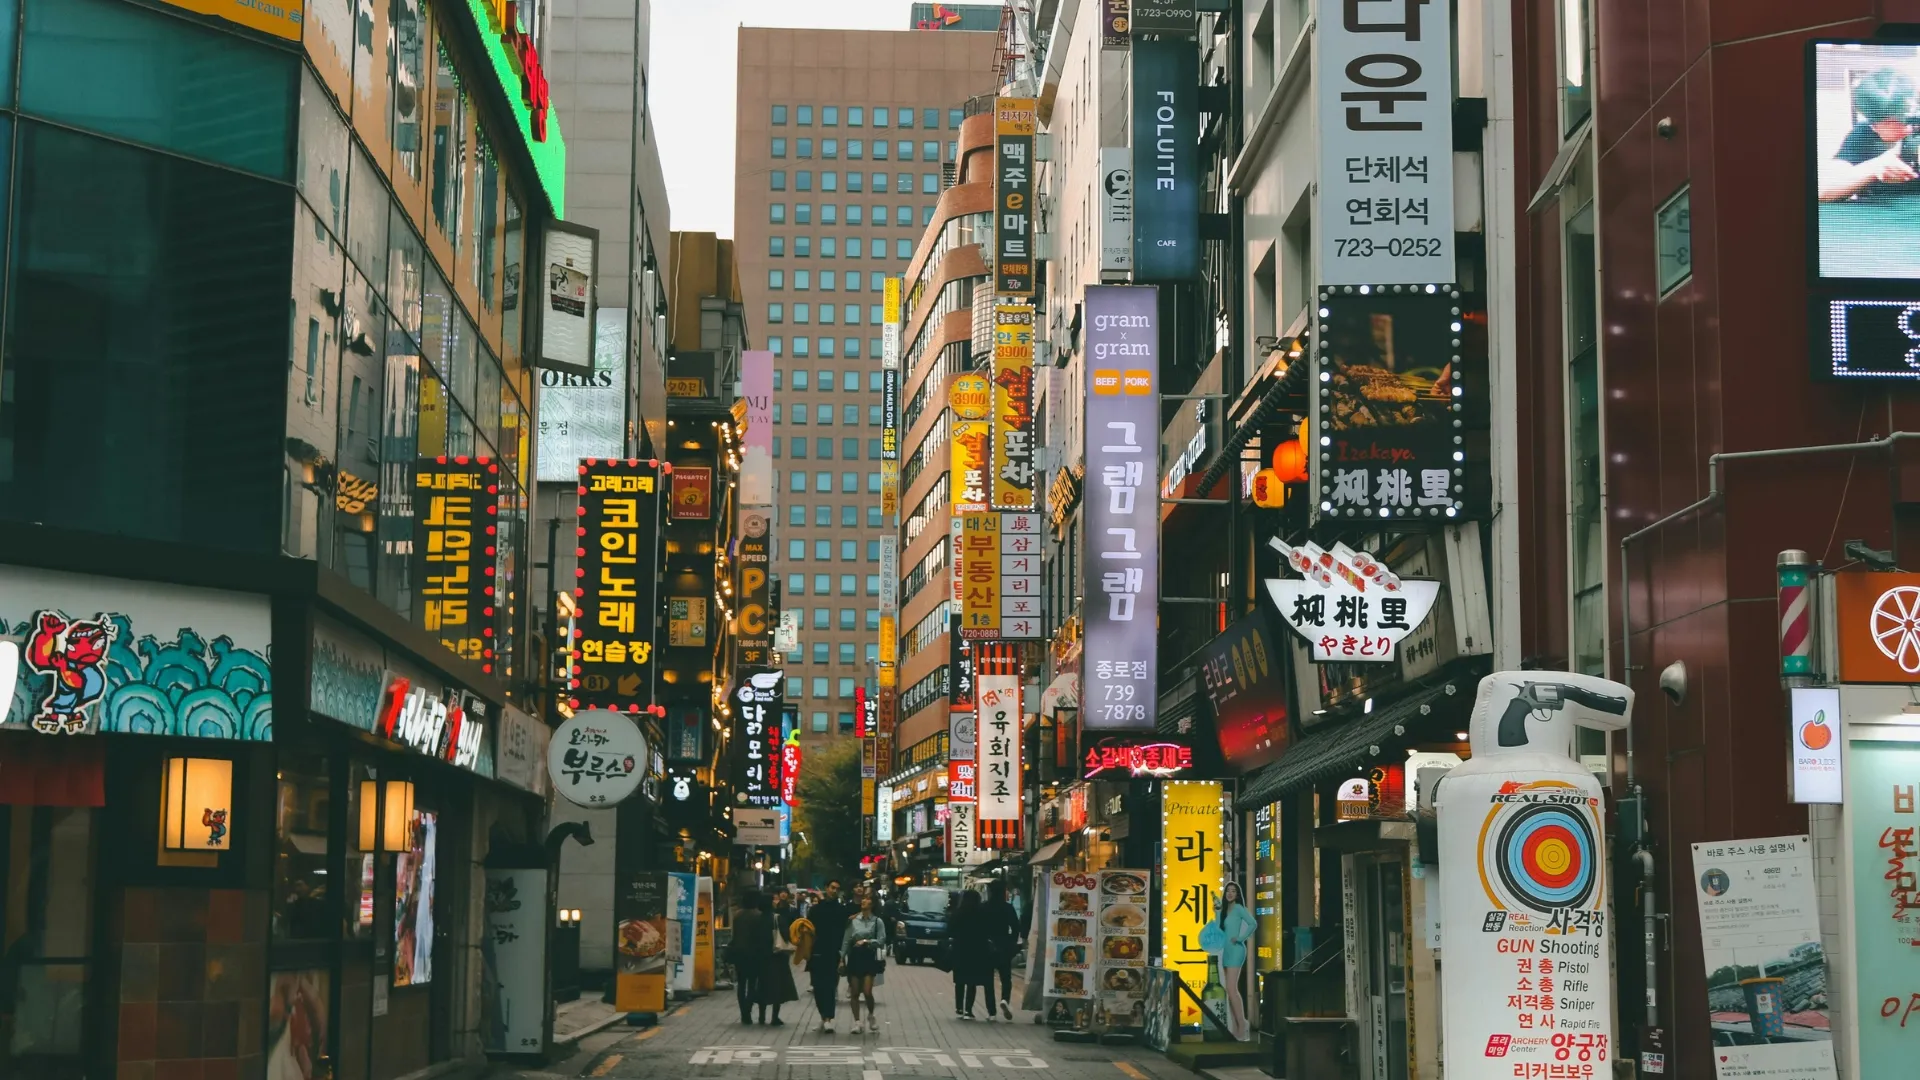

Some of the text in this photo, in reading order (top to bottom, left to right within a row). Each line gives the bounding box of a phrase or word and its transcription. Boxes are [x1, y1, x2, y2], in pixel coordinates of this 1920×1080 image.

[1000, 111, 1032, 122] 최저가
[1157, 91, 1175, 191] FOLUITE
[1346, 155, 1429, 185] 단체석
[1346, 197, 1429, 226] 연회석
[1334, 238, 1442, 258] 723-0252
[1095, 313, 1150, 330] gram
[1095, 340, 1150, 359] gram
[1095, 377, 1149, 387] BEEF PORK
[590, 475, 653, 493] 고래고래
[966, 517, 997, 531] 대신
[1101, 421, 1144, 621] 그램그램
[598, 498, 639, 633] 코인노래
[966, 536, 995, 609] 부동산
[741, 568, 765, 635] PC
[970, 612, 991, 626] 1층
[582, 640, 652, 664] 연습장
[1319, 635, 1391, 657] やきとり
[1095, 660, 1148, 679] 종로점
[1105, 684, 1135, 700] 739
[1096, 704, 1146, 720] -7878
[989, 710, 1011, 803] 육회지존
[1167, 802, 1219, 815] Private
[1490, 794, 1589, 805] REAL SHOT
[954, 806, 968, 863] 황소곱창
[1707, 843, 1796, 858] 바로 주스 사용 설명서
[1508, 924, 1545, 932] Reaction
[1546, 908, 1604, 937] 사격장
[1497, 938, 1600, 959] GUN Shooting
[1558, 961, 1590, 974] Pistol
[1563, 979, 1589, 992] Rifle
[1507, 995, 1595, 1012] 저격총 Sniper
[1560, 1018, 1586, 1031] Rapid
[1587, 1019, 1601, 1029] Fire
[1490, 1036, 1509, 1045] 프리
[1511, 1037, 1550, 1045] ARCHERY
[1550, 1032, 1608, 1062] 양궁장
[1513, 1062, 1594, 1080] 리커브보우
